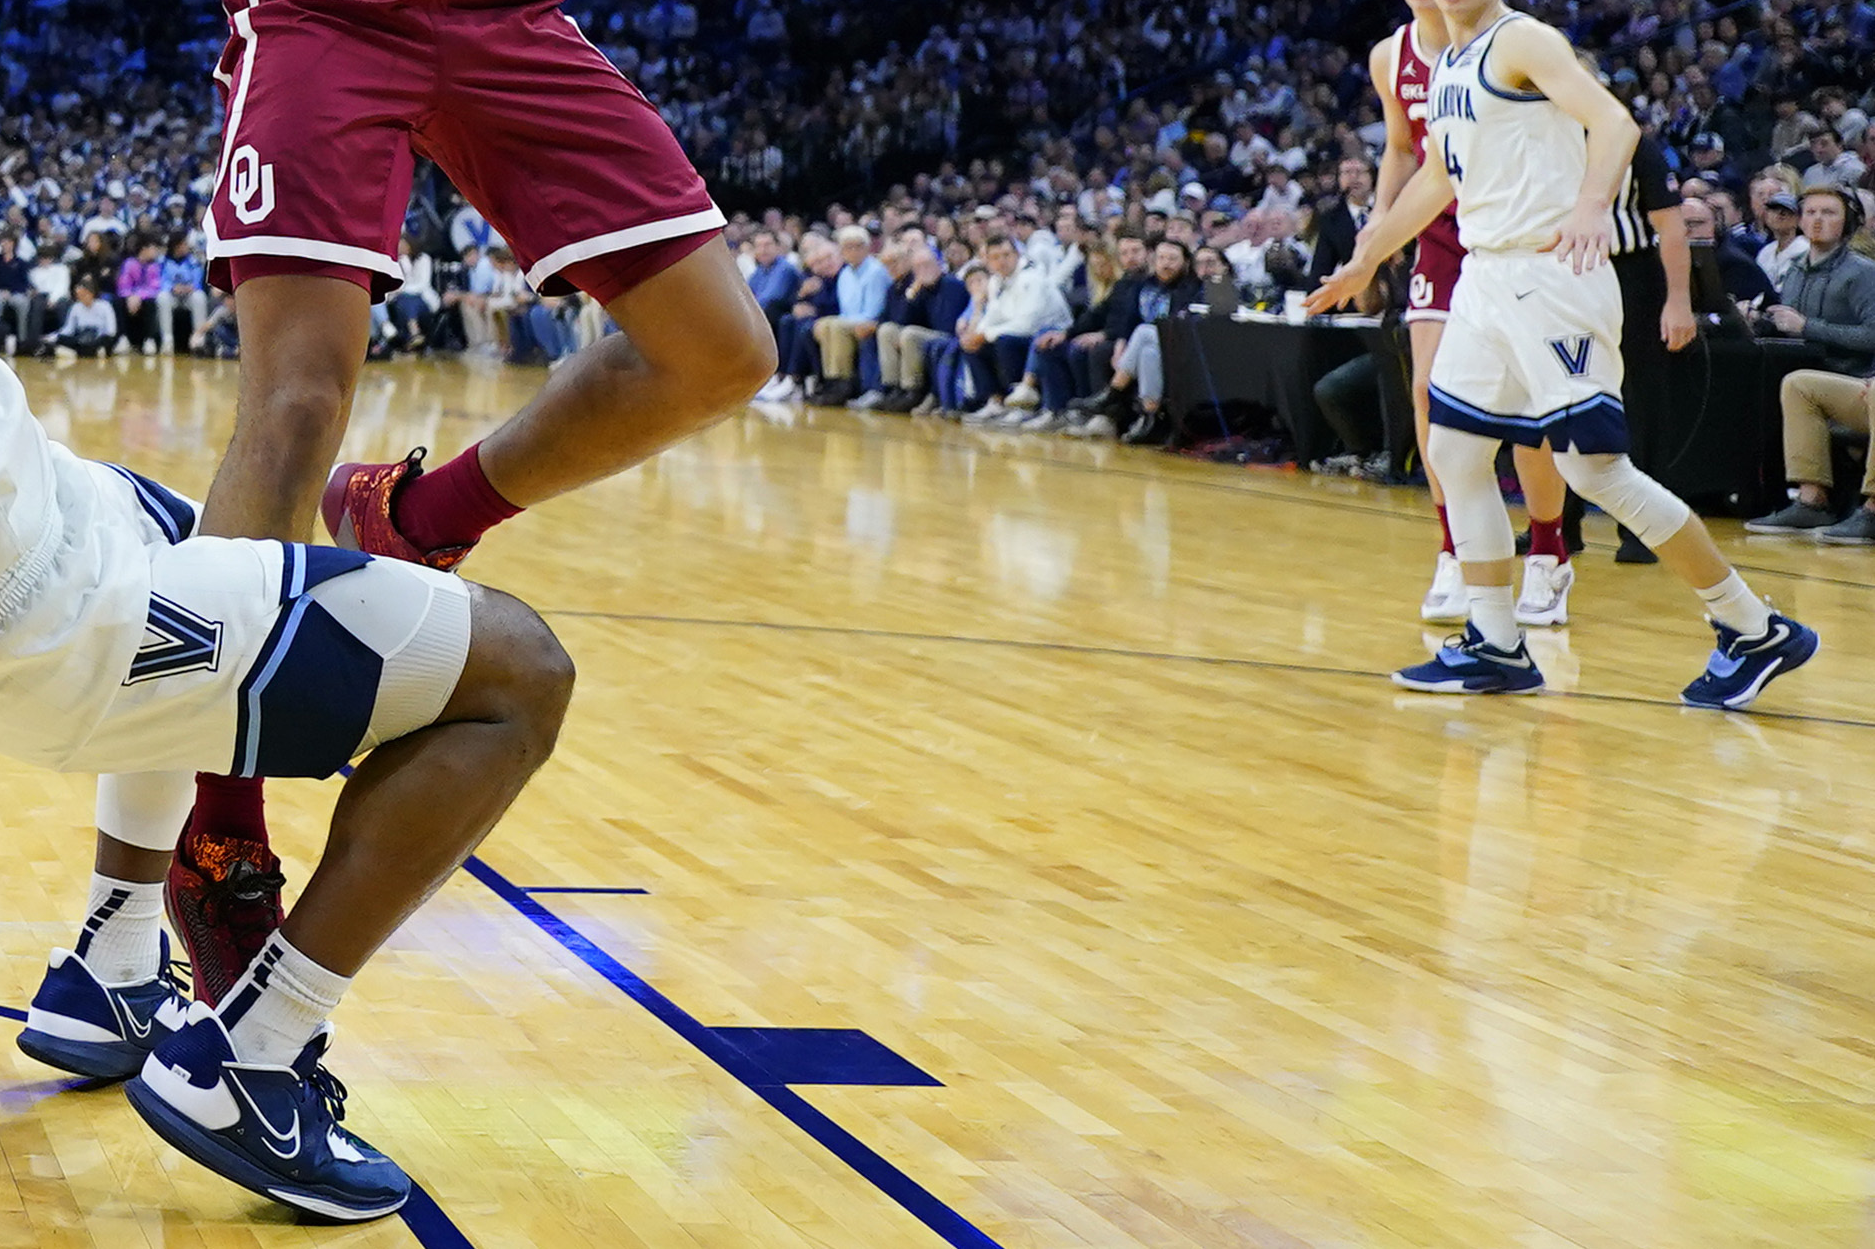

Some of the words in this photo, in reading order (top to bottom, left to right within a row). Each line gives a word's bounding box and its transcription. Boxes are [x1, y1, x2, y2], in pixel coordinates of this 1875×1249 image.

[229, 143, 276, 226] OU
[1544, 331, 1596, 379] V
[120, 591, 224, 687] V
